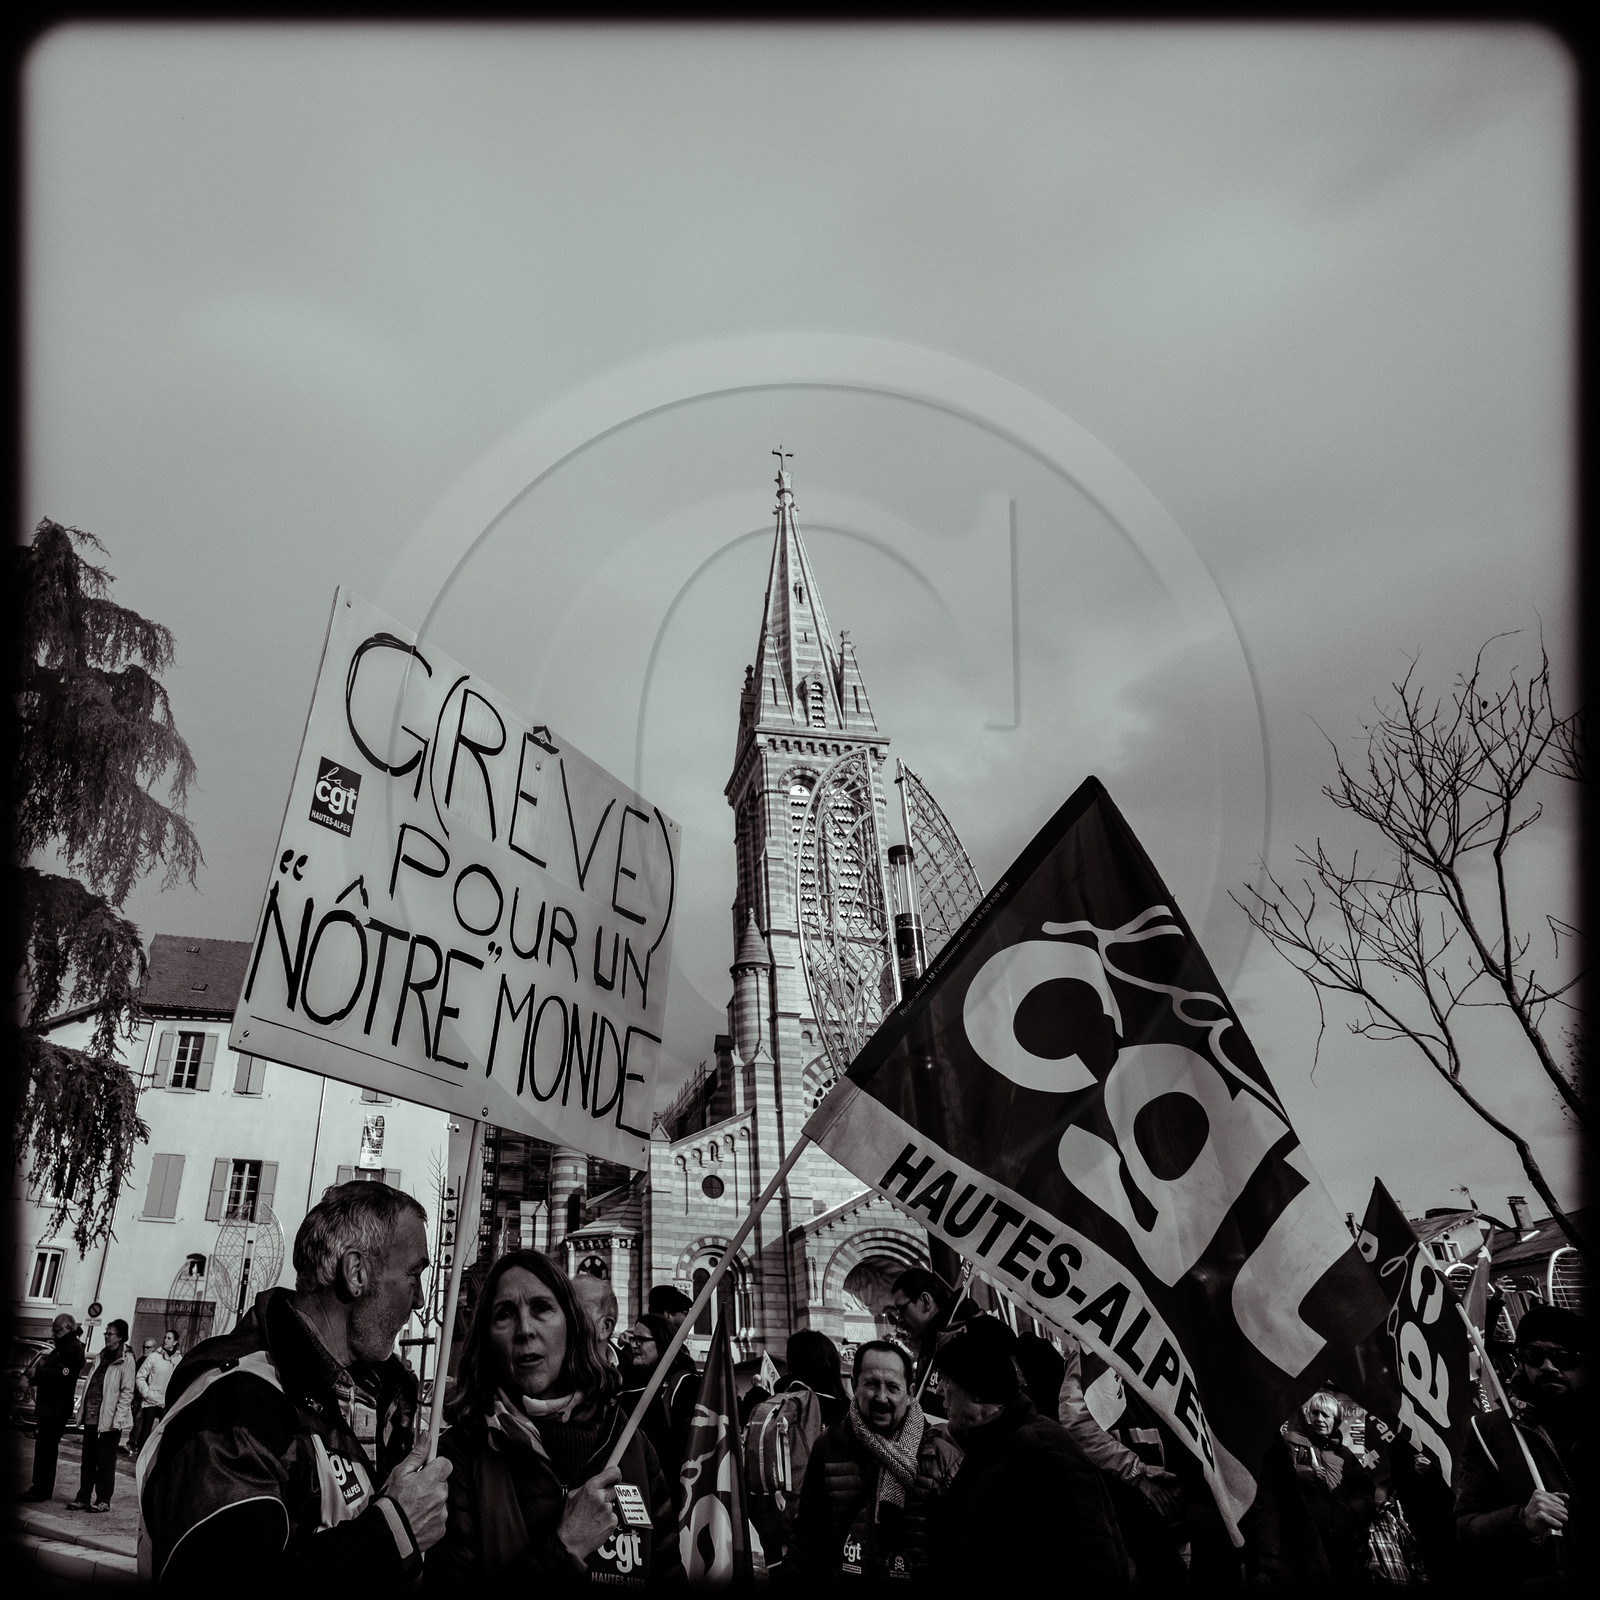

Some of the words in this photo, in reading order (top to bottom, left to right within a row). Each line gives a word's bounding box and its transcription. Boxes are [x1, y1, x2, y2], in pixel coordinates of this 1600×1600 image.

[315, 780, 357, 815] cgt
[311, 809, 351, 833] HAUTES-ALPES
[389, 822, 578, 983] POUR
[594, 925, 652, 1009] UN
[485, 974, 662, 1141] MONDE
[963, 939, 1356, 1379] cgt
[878, 1143, 1216, 1473] HAUTES-ALPES
[615, 1486, 632, 1498] Non
[597, 1528, 643, 1574] cgt
[843, 1542, 862, 1563] cgt
